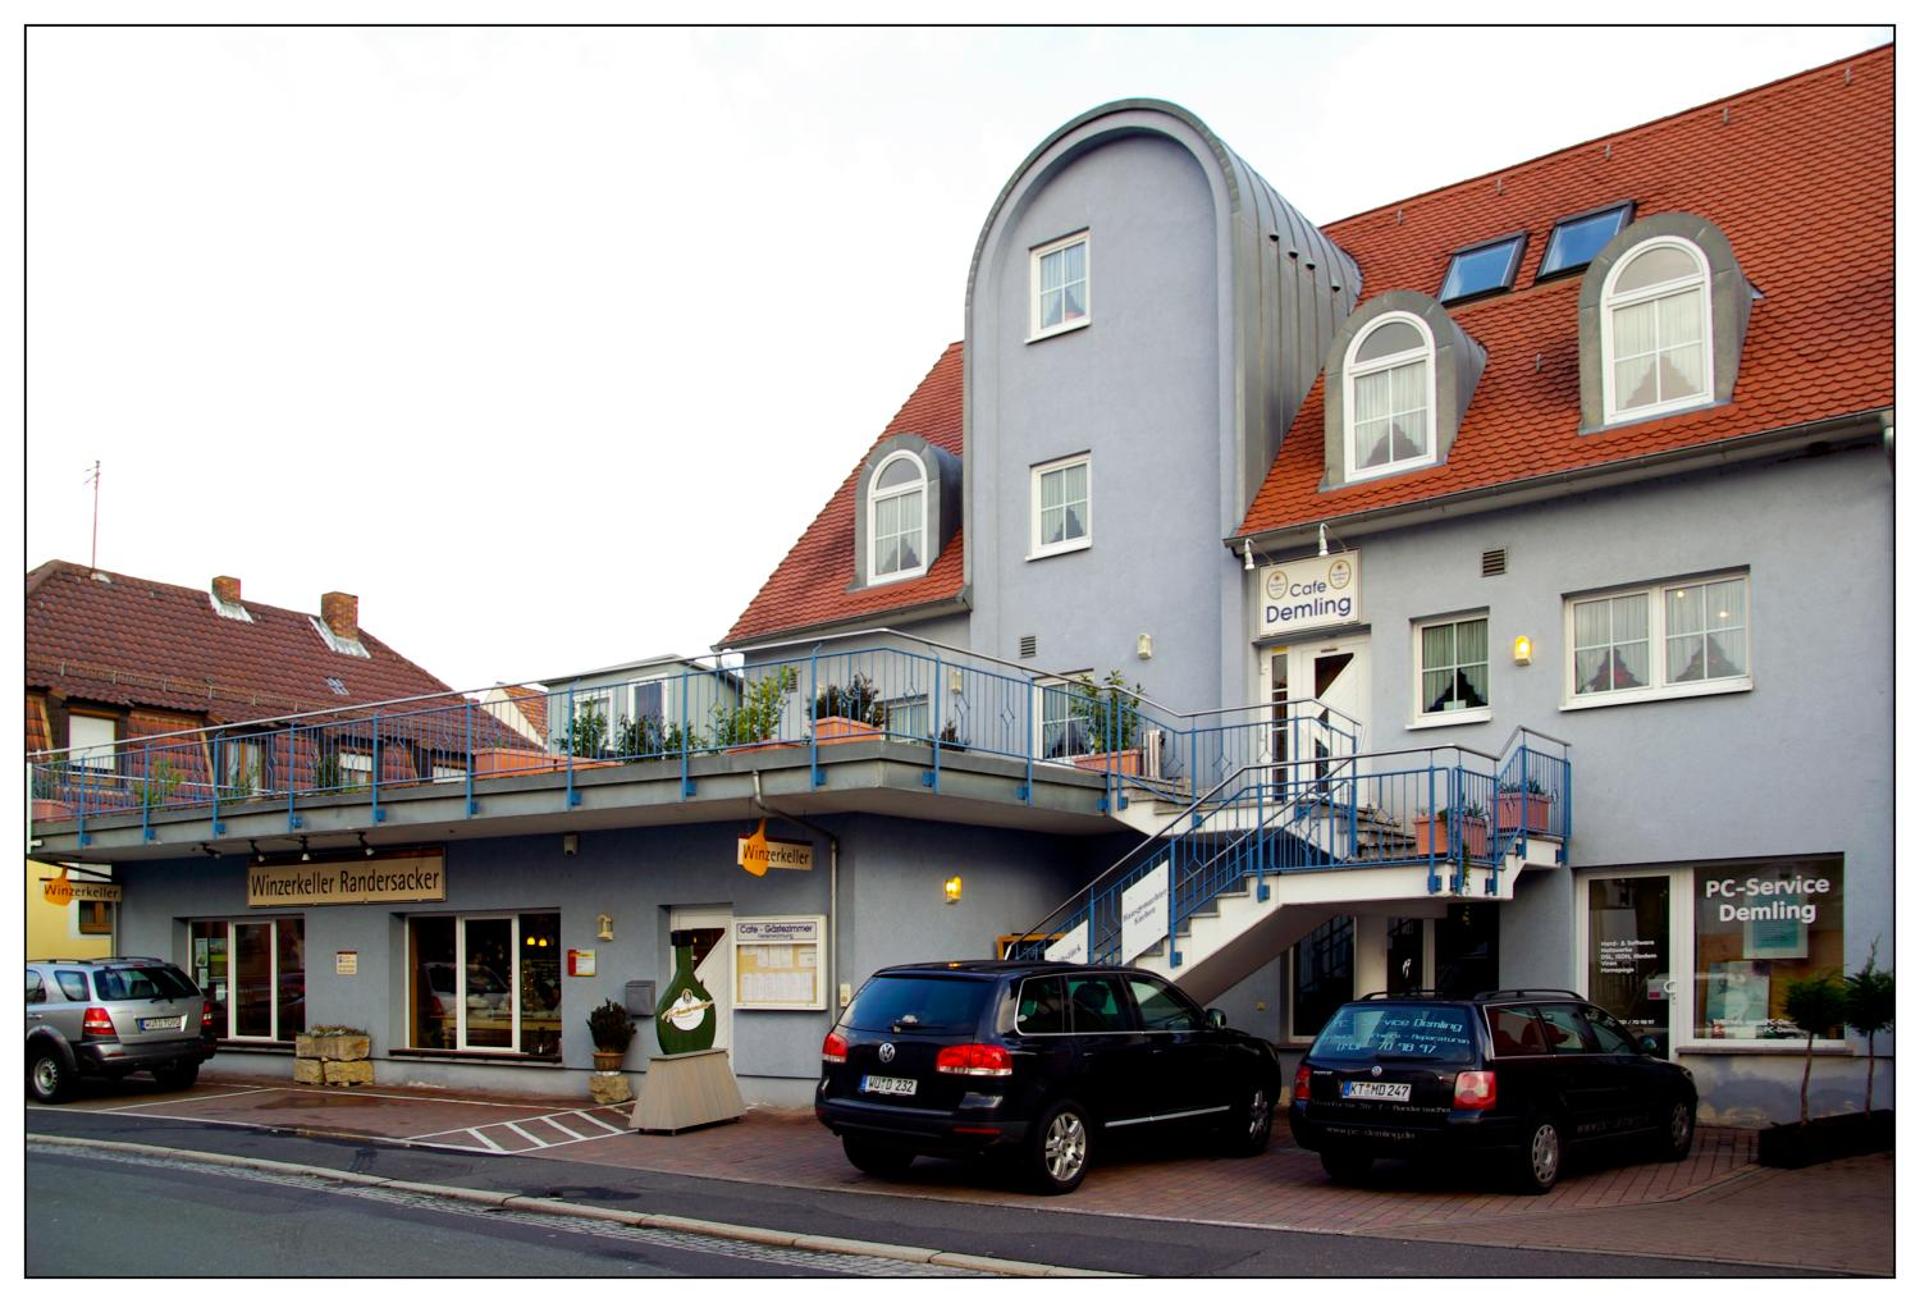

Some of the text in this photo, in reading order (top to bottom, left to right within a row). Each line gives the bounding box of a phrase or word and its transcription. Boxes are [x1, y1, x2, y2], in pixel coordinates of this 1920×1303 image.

[1289, 580, 1327, 597] Cafe
[1266, 597, 1351, 624] Demling
[743, 844, 809, 864] Winzerkeller
[44, 884, 118, 898] Winzerkeller
[252, 866, 440, 896] Winzerkeller Randersacker
[1705, 875, 1830, 898] PC-Service
[1719, 901, 1817, 924] Demling
[1387, 1085, 1409, 1097] 247
